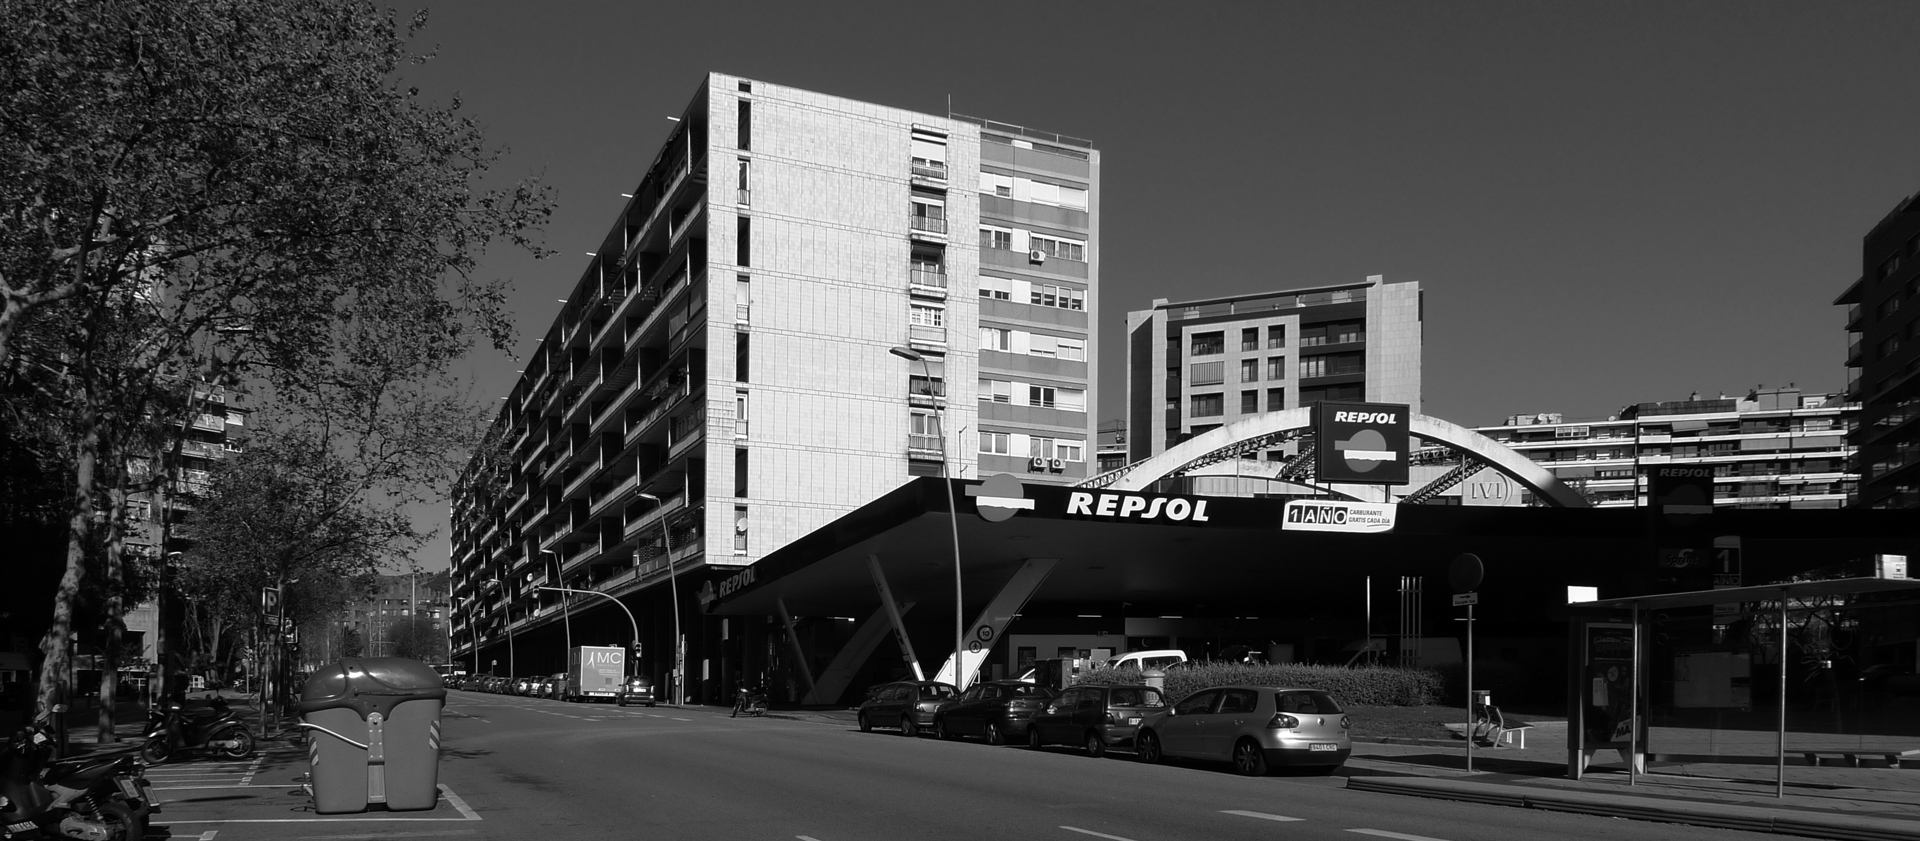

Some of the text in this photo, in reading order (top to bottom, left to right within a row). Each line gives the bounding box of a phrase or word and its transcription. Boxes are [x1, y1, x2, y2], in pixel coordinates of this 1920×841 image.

[1334, 410, 1397, 425] REPSOL
[1659, 468, 1711, 478] REPSOL
[1066, 491, 1209, 522] REPSOL
[1349, 509, 1383, 517] CARBURANTE
[1290, 506, 1347, 525] 1 AÑO
[1348, 516, 1367, 524] GRATIS
[1716, 549, 1730, 574] 1
[719, 565, 756, 599] REPSOL
[267, 591, 278, 613] P
[597, 651, 622, 664] MC
[6, 820, 39, 833] YAMAHA
